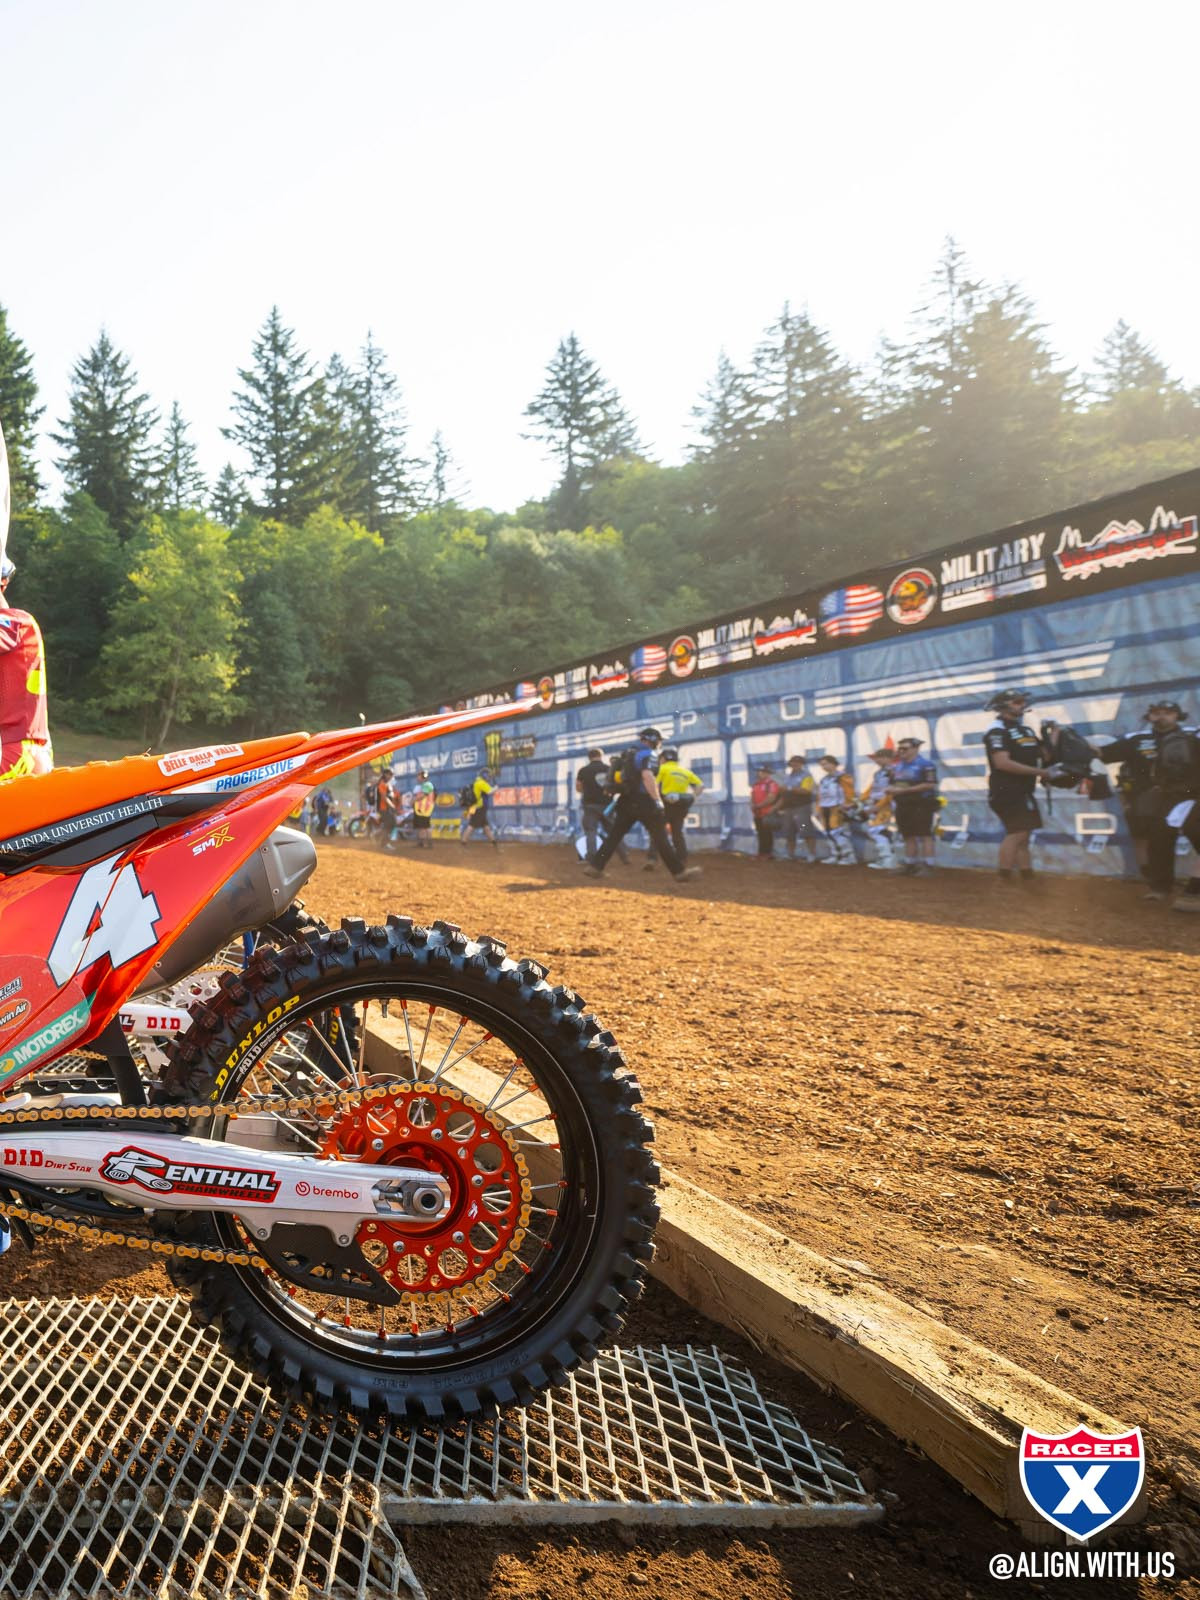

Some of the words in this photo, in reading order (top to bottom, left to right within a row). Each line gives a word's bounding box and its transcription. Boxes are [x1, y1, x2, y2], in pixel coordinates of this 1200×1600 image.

[941, 531, 1046, 585] MILITARY
[163, 757, 187, 773] SELLE
[188, 751, 213, 764] DALLA
[214, 745, 238, 756] VALLE
[216, 758, 294, 792] PROGRESSIVE
[14, 831, 50, 850] LINDA
[50, 809, 115, 839] UNIVERSITY
[117, 796, 164, 818] HEALTH
[192, 826, 235, 857] SMX
[47, 849, 163, 989] 4
[14, 1001, 28, 1018] Air
[13, 1009, 83, 1064] MOTOREX
[215, 995, 300, 1090] DUNLOP
[104, 1151, 277, 1191] RENTHAL
[176, 1183, 273, 1201] CHAINWHEELS
[313, 1185, 359, 1200] brembo
